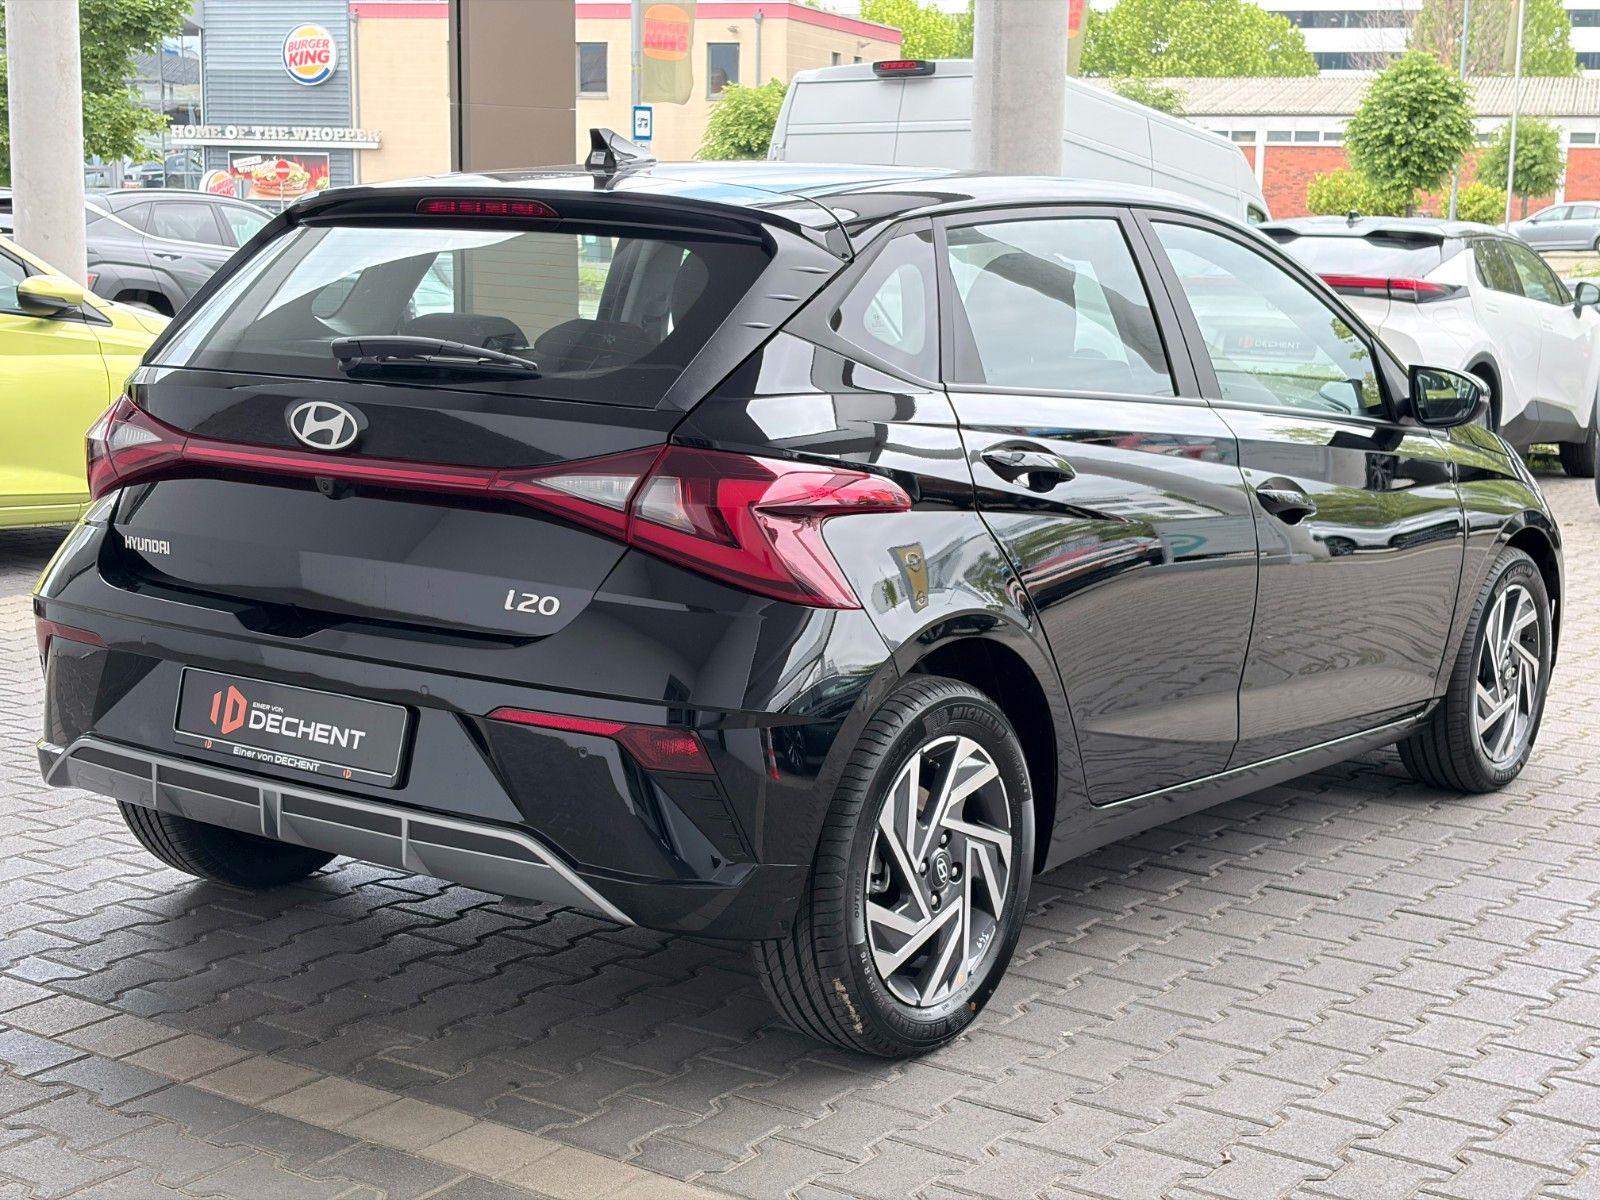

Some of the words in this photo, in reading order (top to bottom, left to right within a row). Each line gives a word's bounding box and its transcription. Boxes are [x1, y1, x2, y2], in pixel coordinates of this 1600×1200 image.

[288, 39, 330, 52] BURGER
[288, 50, 330, 68] KING
[170, 125, 221, 139] HOME
[225, 125, 249, 139] OF
[252, 126, 291, 141] THE
[292, 127, 380, 143] WHOPPER
[124, 534, 170, 555] HYUNDAI
[252, 701, 270, 711] EINER
[271, 705, 284, 713] VON
[248, 709, 366, 750] DECHENT
[950, 705, 1009, 741] MICHELIN
[232, 746, 257, 759] Einer
[257, 752, 274, 762] von
[274, 755, 321, 772] DECHENT
[860, 951, 867, 964] 16
[863, 965, 870, 975] R
